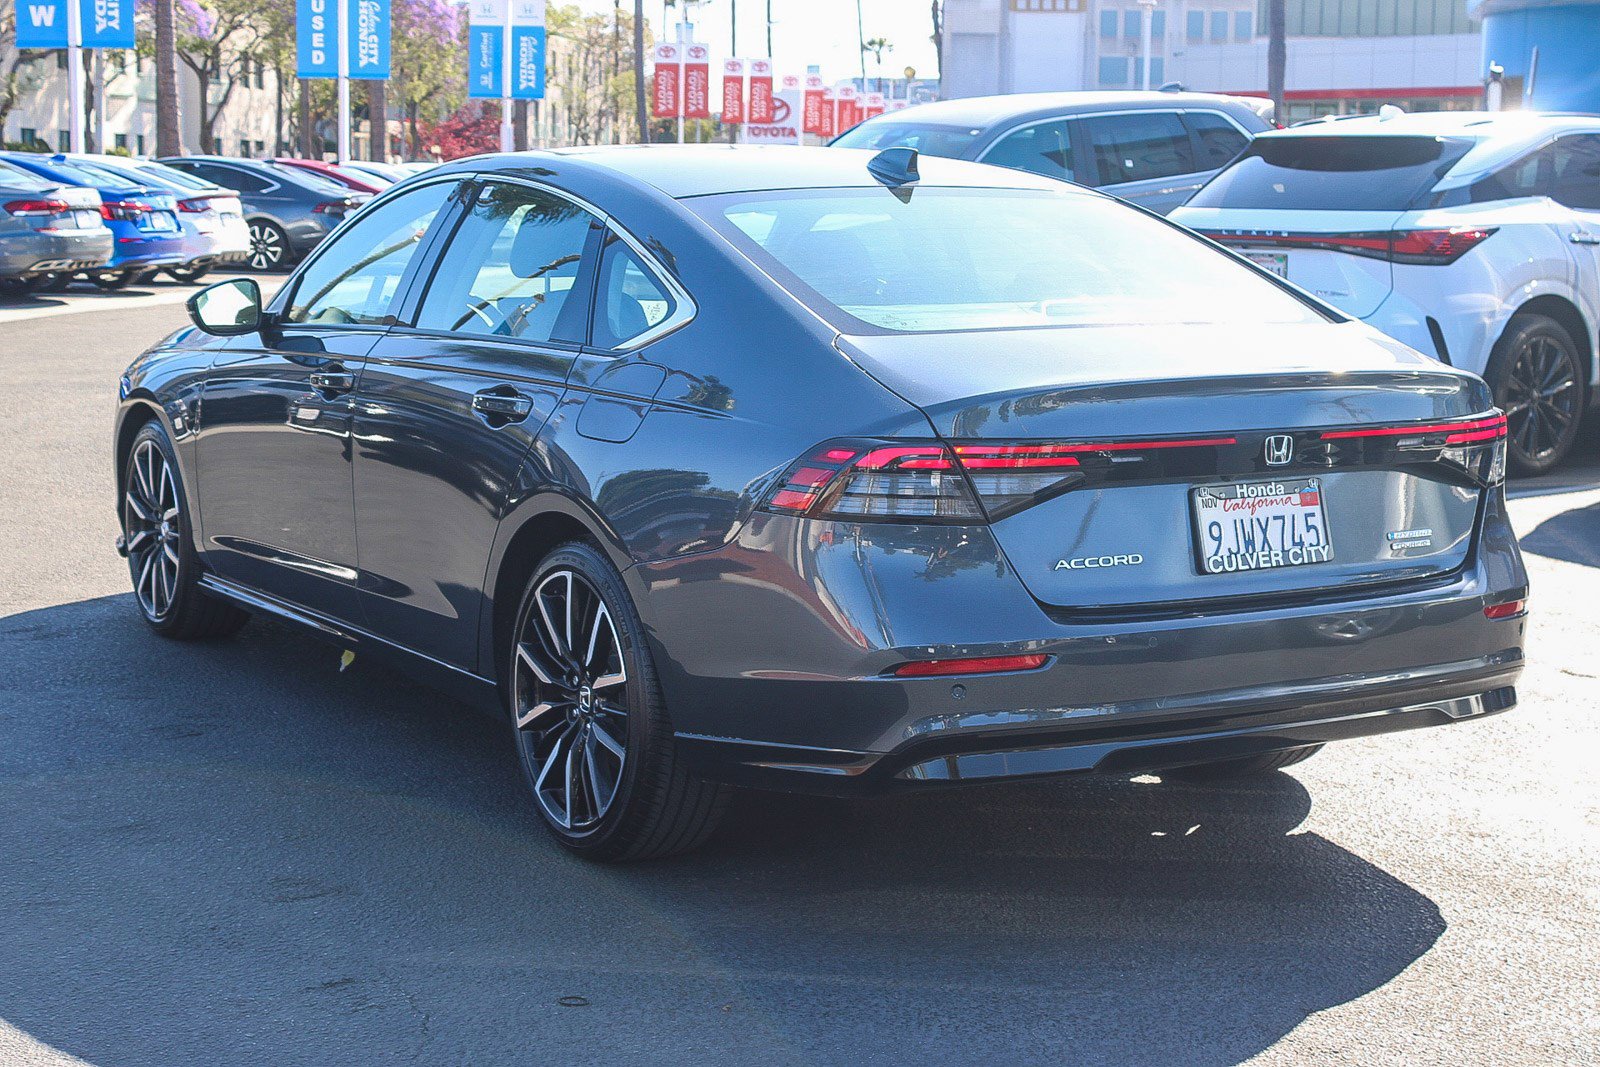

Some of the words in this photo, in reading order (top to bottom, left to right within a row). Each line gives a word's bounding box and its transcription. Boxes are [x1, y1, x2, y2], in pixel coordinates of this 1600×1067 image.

[311, 0, 325, 65] USED
[358, 0, 369, 68] HONDA
[368, 34, 379, 66] CITY
[519, 36, 528, 90] HONDA
[527, 63, 536, 89] CITY
[657, 70, 667, 112] TOYOTA
[688, 70, 698, 112] TOYOTA
[725, 82, 733, 120] TOYOTA
[752, 82, 761, 120] TOYOTA
[748, 126, 797, 138] TOYOTA
[1202, 497, 1218, 510] NOV
[1224, 496, 1300, 516] California
[1235, 482, 1285, 499] Honda
[1208, 512, 1321, 558] 9JWX745
[1054, 553, 1143, 571] ACCORD
[1208, 550, 1284, 574] CULVER
[1288, 544, 1330, 566] CITY
